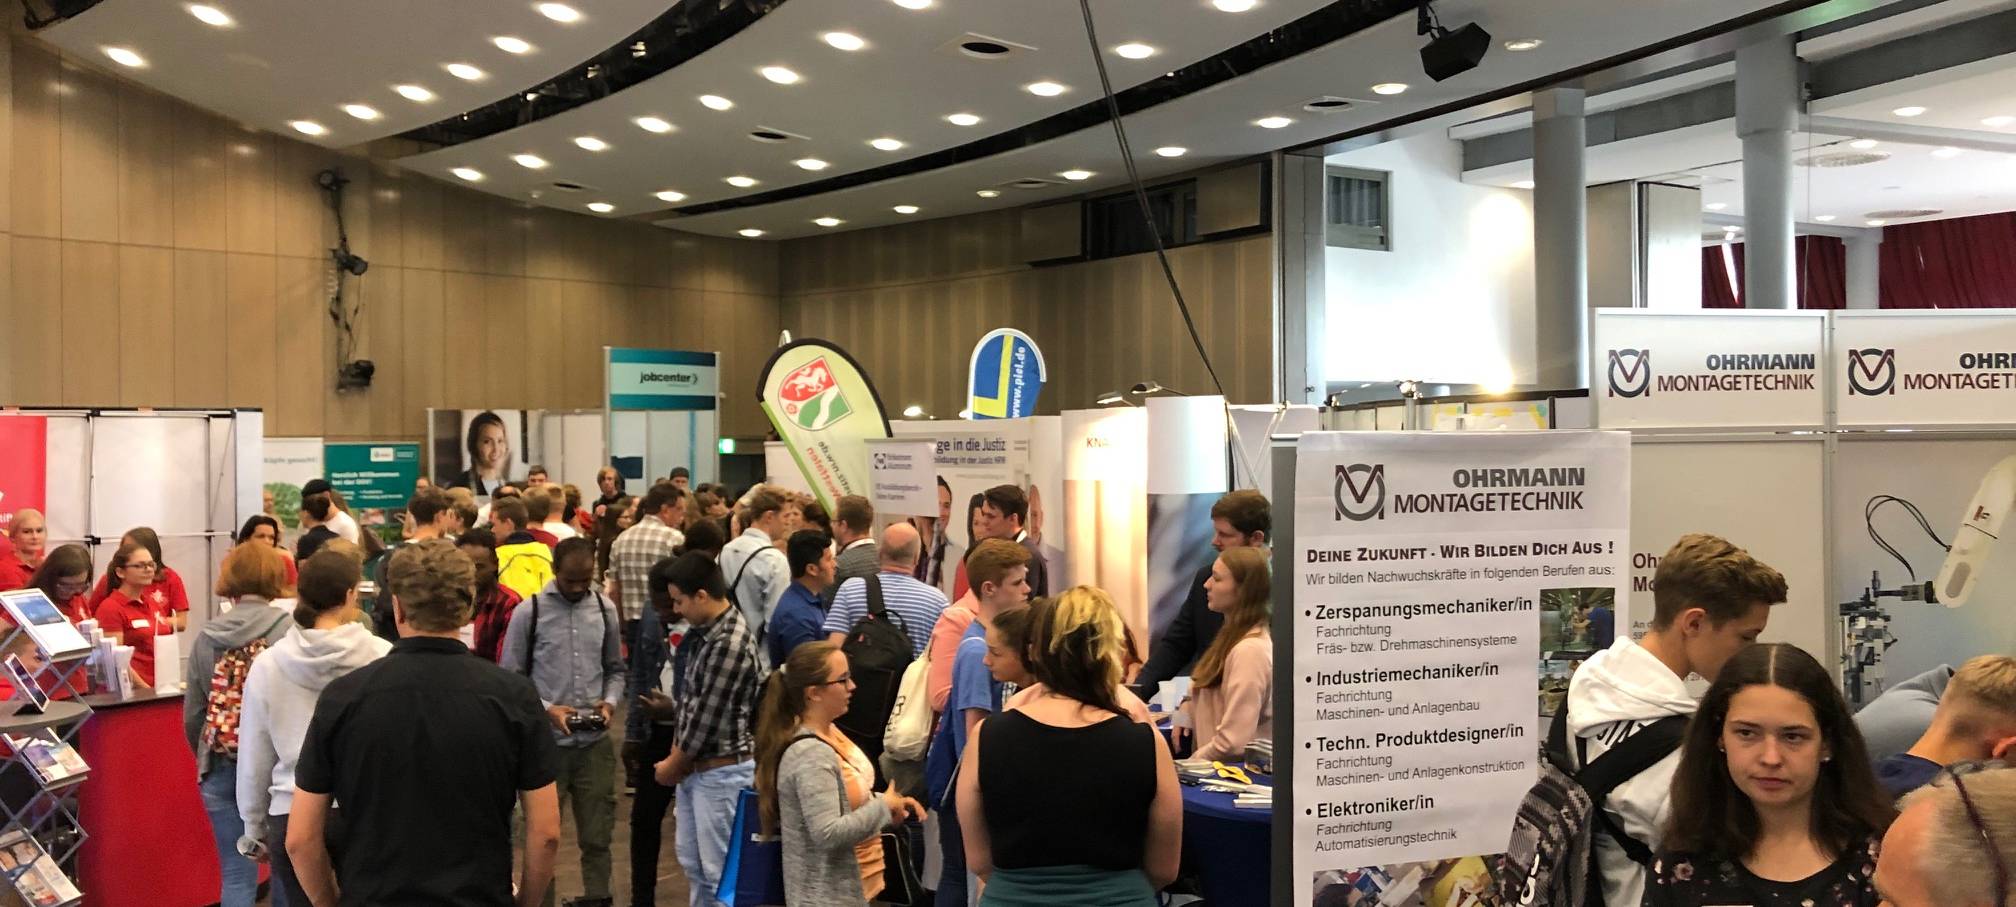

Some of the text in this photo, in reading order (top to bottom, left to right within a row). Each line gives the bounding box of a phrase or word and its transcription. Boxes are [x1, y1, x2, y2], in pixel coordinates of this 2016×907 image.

[1706, 354, 1814, 370] OHRMANN
[640, 372, 691, 384] jobcenter
[1658, 374, 1814, 391] MONTAGETECHNIK
[954, 438, 963, 451] in
[966, 438, 980, 451] die
[982, 438, 1006, 451] Justiz
[1453, 467, 1585, 488] OHRMANN
[1394, 491, 1584, 514] MONTAGETECHNIK
[1307, 549, 1351, 563] DEINE
[1357, 547, 1427, 562] ZUKUNFT
[1440, 544, 1470, 558] WIR
[1475, 543, 1527, 558] BILDEN
[1532, 542, 1567, 556] DICH
[1572, 541, 1602, 555] AUS
[1306, 565, 1615, 586] Wir bilden Nachwuchskräfte in folgenden Berufen aus:
[1316, 597, 1532, 622] Zerspanungsmechaniker/in
[1316, 624, 1392, 638] Fachrichtung
[1317, 634, 1518, 654] Fräs- bzw. Drehmaschinensysteme
[1317, 662, 1499, 686] Industriemechaniker/in
[1316, 690, 1392, 704] Fachrichtung
[1316, 700, 1480, 720] Maschinen- und Anlagenbau
[1316, 724, 1524, 752] Techn. Produktdesigner/in
[1316, 754, 1392, 770] Fachrichtung
[1316, 760, 1525, 786] Maschinen- und Anlagenkonstruktion
[1317, 794, 1434, 818] Elektroniker/in
[1316, 820, 1392, 836] Fachrichtung
[1315, 829, 1457, 852] Automatisierungstechnik
